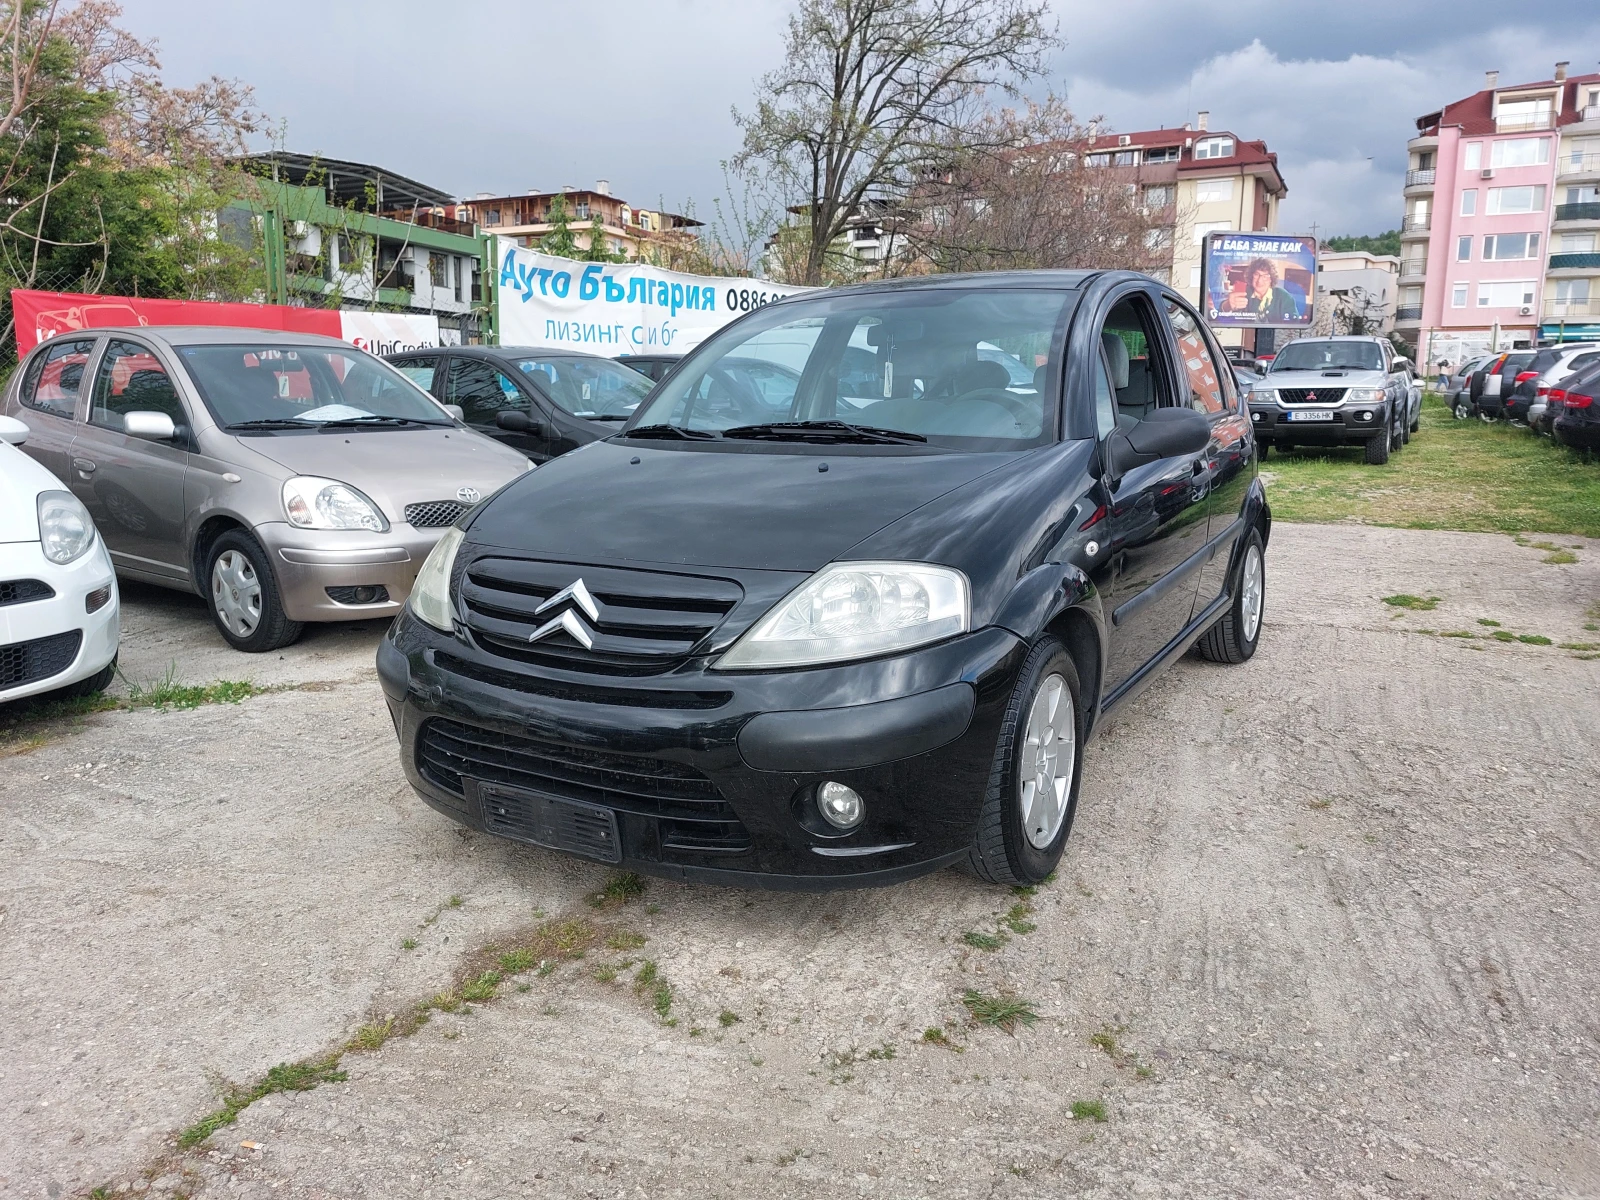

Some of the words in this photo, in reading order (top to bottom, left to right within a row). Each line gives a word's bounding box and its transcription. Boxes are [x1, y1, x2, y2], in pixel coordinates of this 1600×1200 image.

[1212, 239, 1222, 250] И
[1223, 240, 1250, 251] БАБА
[1252, 241, 1280, 252] ЗНАЕ
[1280, 242, 1303, 253] КАК
[500, 248, 571, 303] Ауто
[579, 265, 716, 317] България
[545, 319, 624, 345] лизинг
[1294, 412, 1300, 420] E
[1303, 412, 1321, 420] 3356
